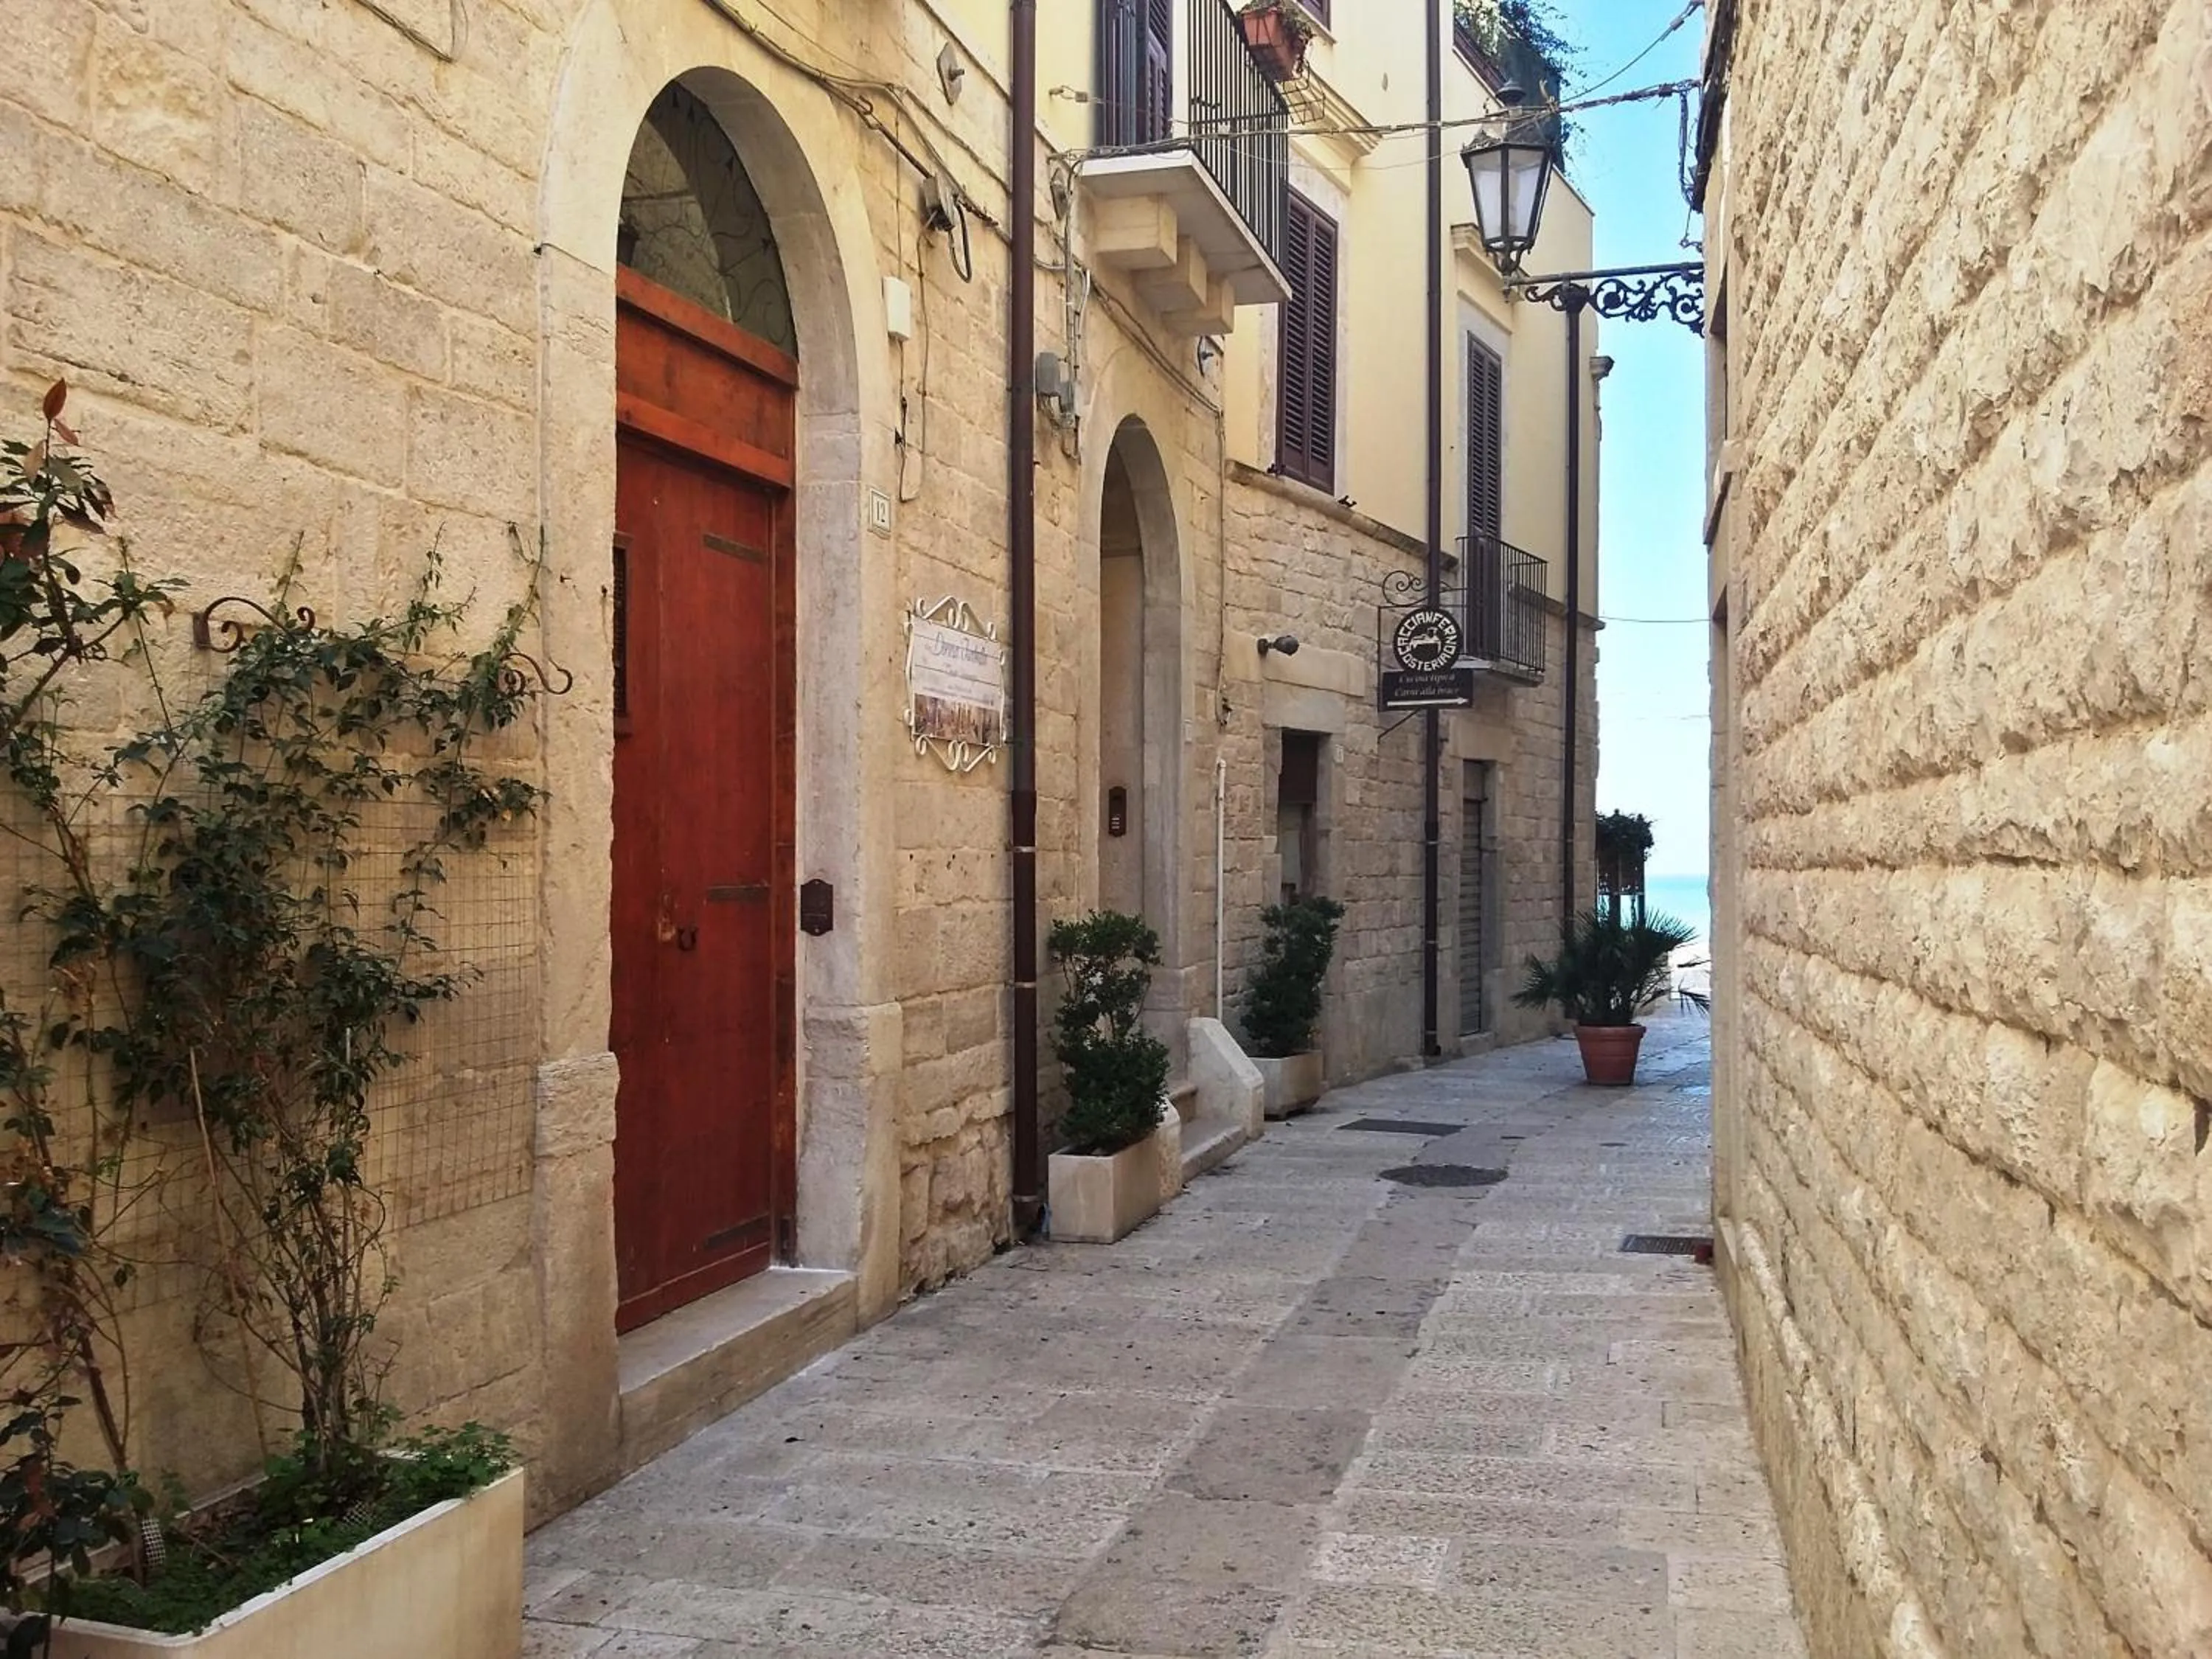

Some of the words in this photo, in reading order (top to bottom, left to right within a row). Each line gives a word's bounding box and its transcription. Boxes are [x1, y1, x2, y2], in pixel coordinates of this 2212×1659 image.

[877, 501, 886, 523] 12
[1397, 611, 1457, 655] CACCIANFERNO
[1402, 653, 1451, 671] OSTERIA
